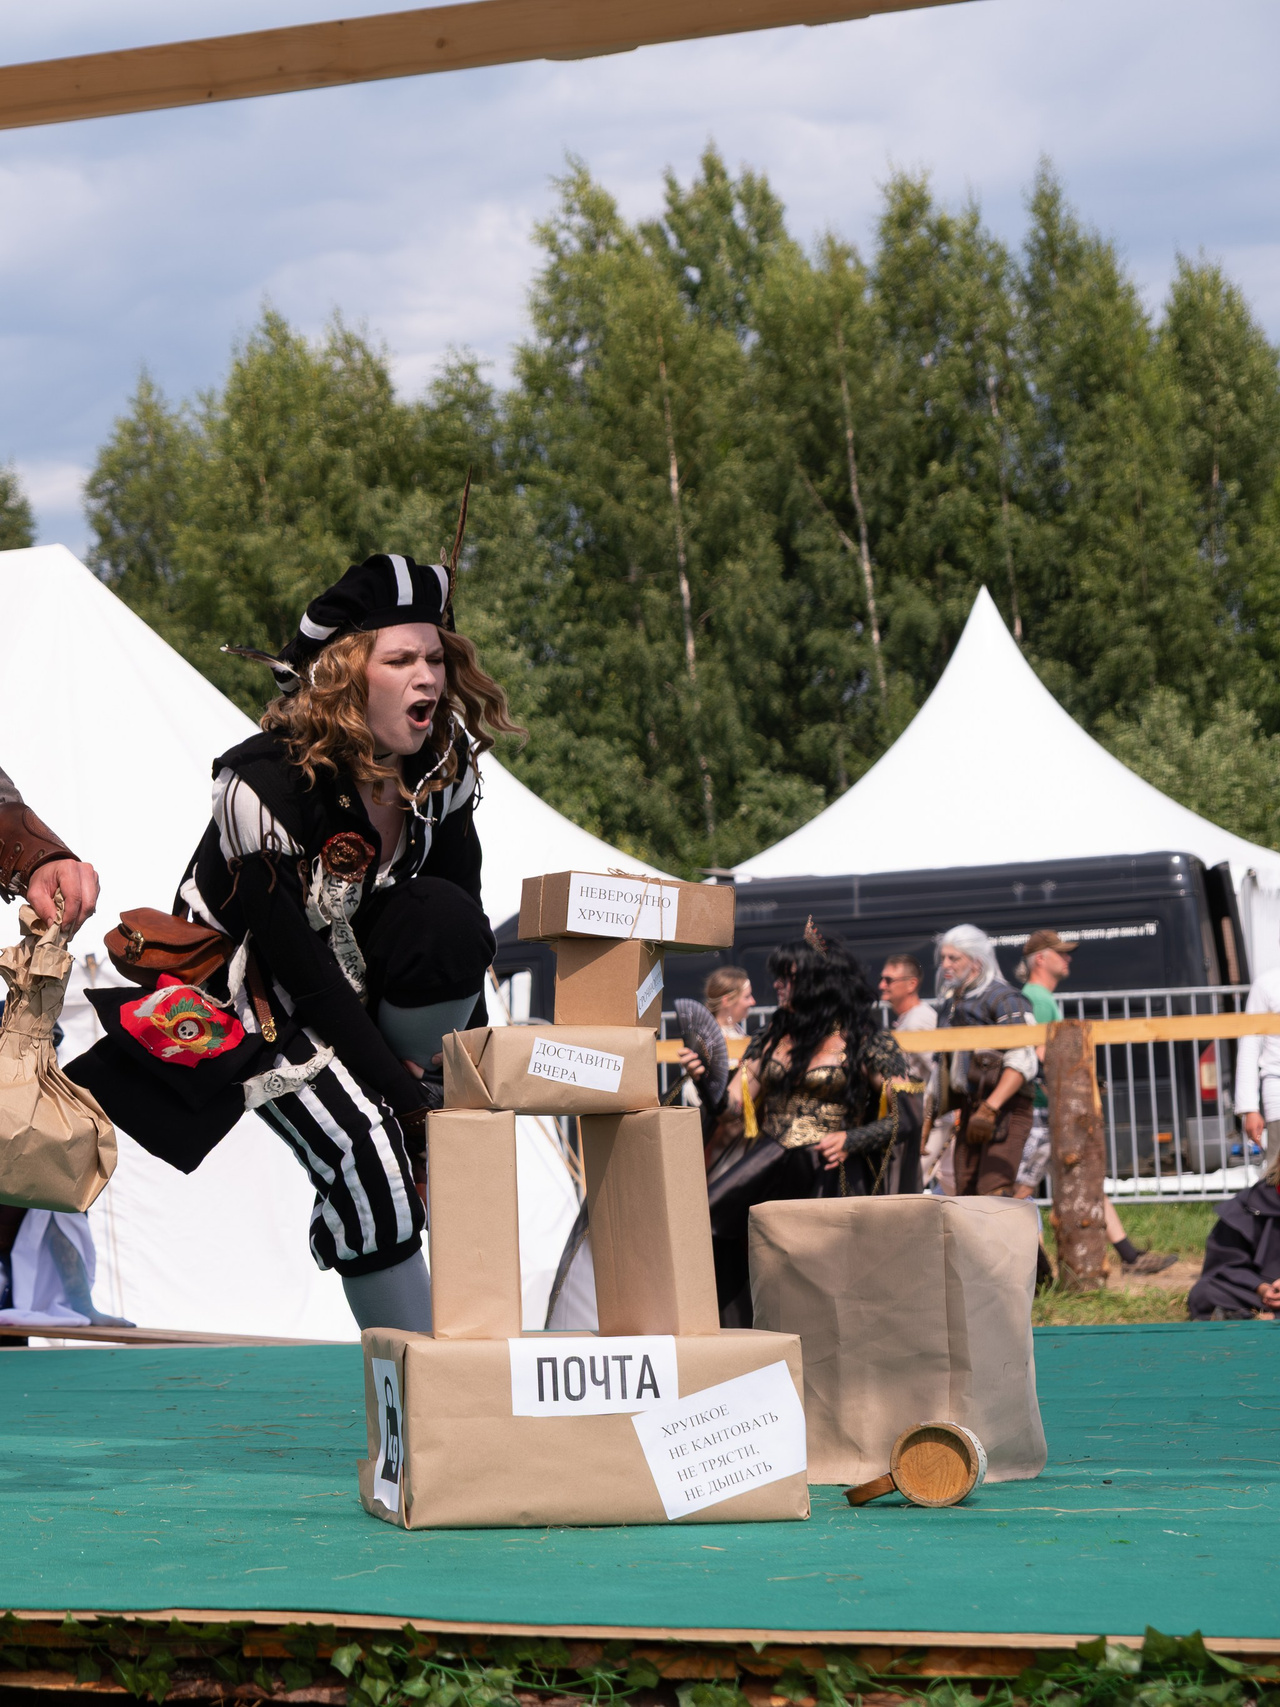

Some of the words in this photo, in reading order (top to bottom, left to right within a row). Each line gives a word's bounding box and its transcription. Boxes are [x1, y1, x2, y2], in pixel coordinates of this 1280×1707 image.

[580, 885, 671, 909] НЕВЕРОЯТНО
[577, 908, 635, 926] ХРУПКО
[532, 1061, 577, 1083] ВЧЕРА
[535, 1042, 621, 1072] ДОСТАВИТЬ
[536, 1354, 661, 1402] ПОЧТА
[660, 1404, 730, 1438] ХРУПКОЕ
[668, 1443, 690, 1460] НЕ
[691, 1411, 779, 1452] КАНТОВАТЬ
[387, 1418, 398, 1475] kg
[676, 1465, 698, 1482] НЕ
[699, 1444, 761, 1474] ТРЯСТИ,
[684, 1484, 706, 1502] НЕ
[708, 1460, 773, 1496] ДЫШАТЬ
